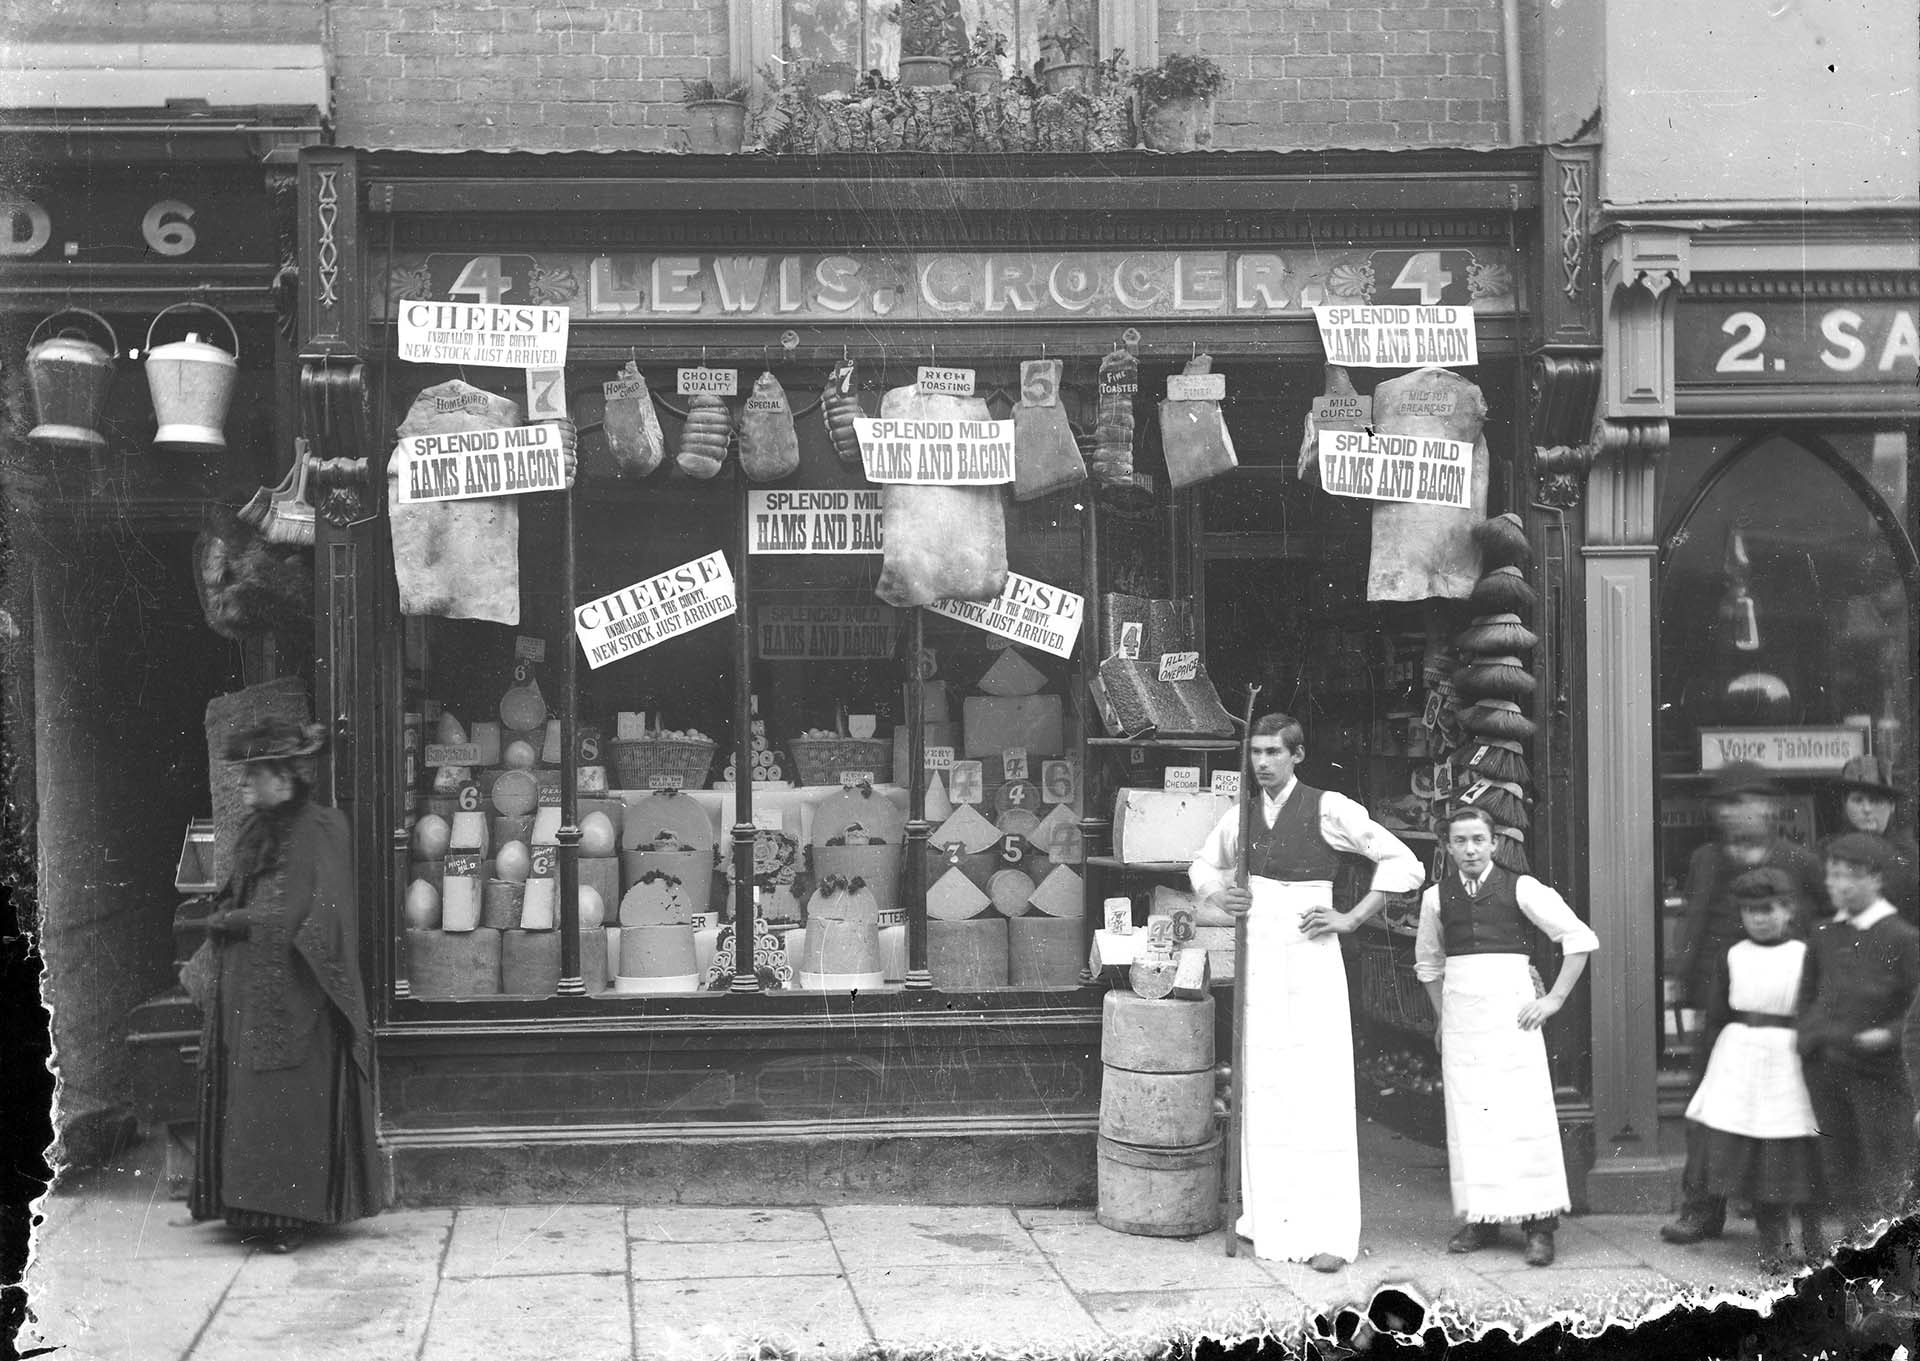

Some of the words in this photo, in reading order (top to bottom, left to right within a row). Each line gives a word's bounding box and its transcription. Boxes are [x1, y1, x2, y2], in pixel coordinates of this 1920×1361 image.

[142, 201, 196, 256] 6
[448, 256, 512, 304] 4
[1391, 252, 1453, 305] 4
[407, 304, 561, 333] CHEESE
[1329, 308, 1410, 325] SPLENDID
[1416, 308, 1457, 324] MILD
[477, 332, 486, 346] IN
[490, 334, 504, 348] THE
[1376, 328, 1411, 363] AND
[1415, 328, 1469, 362] BACON
[1715, 311, 1785, 372] 2.
[405, 343, 432, 359] NEW
[434, 344, 471, 361] STOCK
[474, 347, 503, 363] JUST
[682, 371, 731, 381] CHOICE
[682, 382, 731, 391] QUALITY
[920, 381, 971, 392] TOASTING
[1023, 361, 1053, 401] 5
[1101, 383, 1138, 394] TOASTER
[1107, 370, 1126, 383] FINE
[436, 398, 462, 410] HOME
[531, 370, 561, 413] 7
[1329, 398, 1357, 408] MILD
[748, 400, 781, 410] SPECIAL
[1320, 408, 1363, 419] CURED
[415, 432, 499, 456] SPLENDID
[505, 427, 547, 448] MILD
[872, 421, 954, 439] SPLENDID
[959, 421, 1000, 439] MILD
[1336, 434, 1417, 456] SPLENDID
[1423, 440, 1460, 461] MILD
[410, 457, 459, 499] HAMS
[465, 453, 501, 494] AND
[504, 448, 560, 490] BACON
[917, 443, 952, 481] AND
[958, 442, 1011, 481] BACON
[1325, 455, 1373, 495] HAMS
[1377, 459, 1414, 499] AND
[1417, 462, 1466, 504] BACON
[766, 492, 849, 510] SPLENDID
[854, 492, 883, 510] MIL
[757, 514, 807, 550] HAMS
[812, 514, 847, 550] AND
[851, 514, 883, 550] BAC
[578, 556, 722, 629] CHEESE
[604, 611, 649, 639] UNEQUALLED
[650, 607, 659, 621] IN
[661, 599, 678, 616] THE
[1005, 601, 1020, 617] THE
[592, 639, 622, 663] NEW
[619, 626, 655, 652] STOCK
[656, 614, 683, 637] JUST
[684, 594, 735, 626] ARRIVED.
[951, 600, 987, 623] STOCK
[986, 612, 1017, 634] JUST
[1014, 622, 1064, 651] ARRIVED.
[1123, 626, 1139, 657] 4
[1166, 655, 1183, 667] ALL
[1427, 695, 1440, 726] 6
[1718, 738, 1766, 760] Voice
[1773, 737, 1851, 761] Tabloids
[1165, 780, 1198, 788] CHEDDAR
[1174, 771, 1190, 779] OLD
[459, 786, 478, 810] 6
[1009, 784, 1025, 805] 4
[1003, 836, 1022, 862] 5
[1173, 910, 1193, 941] 6
